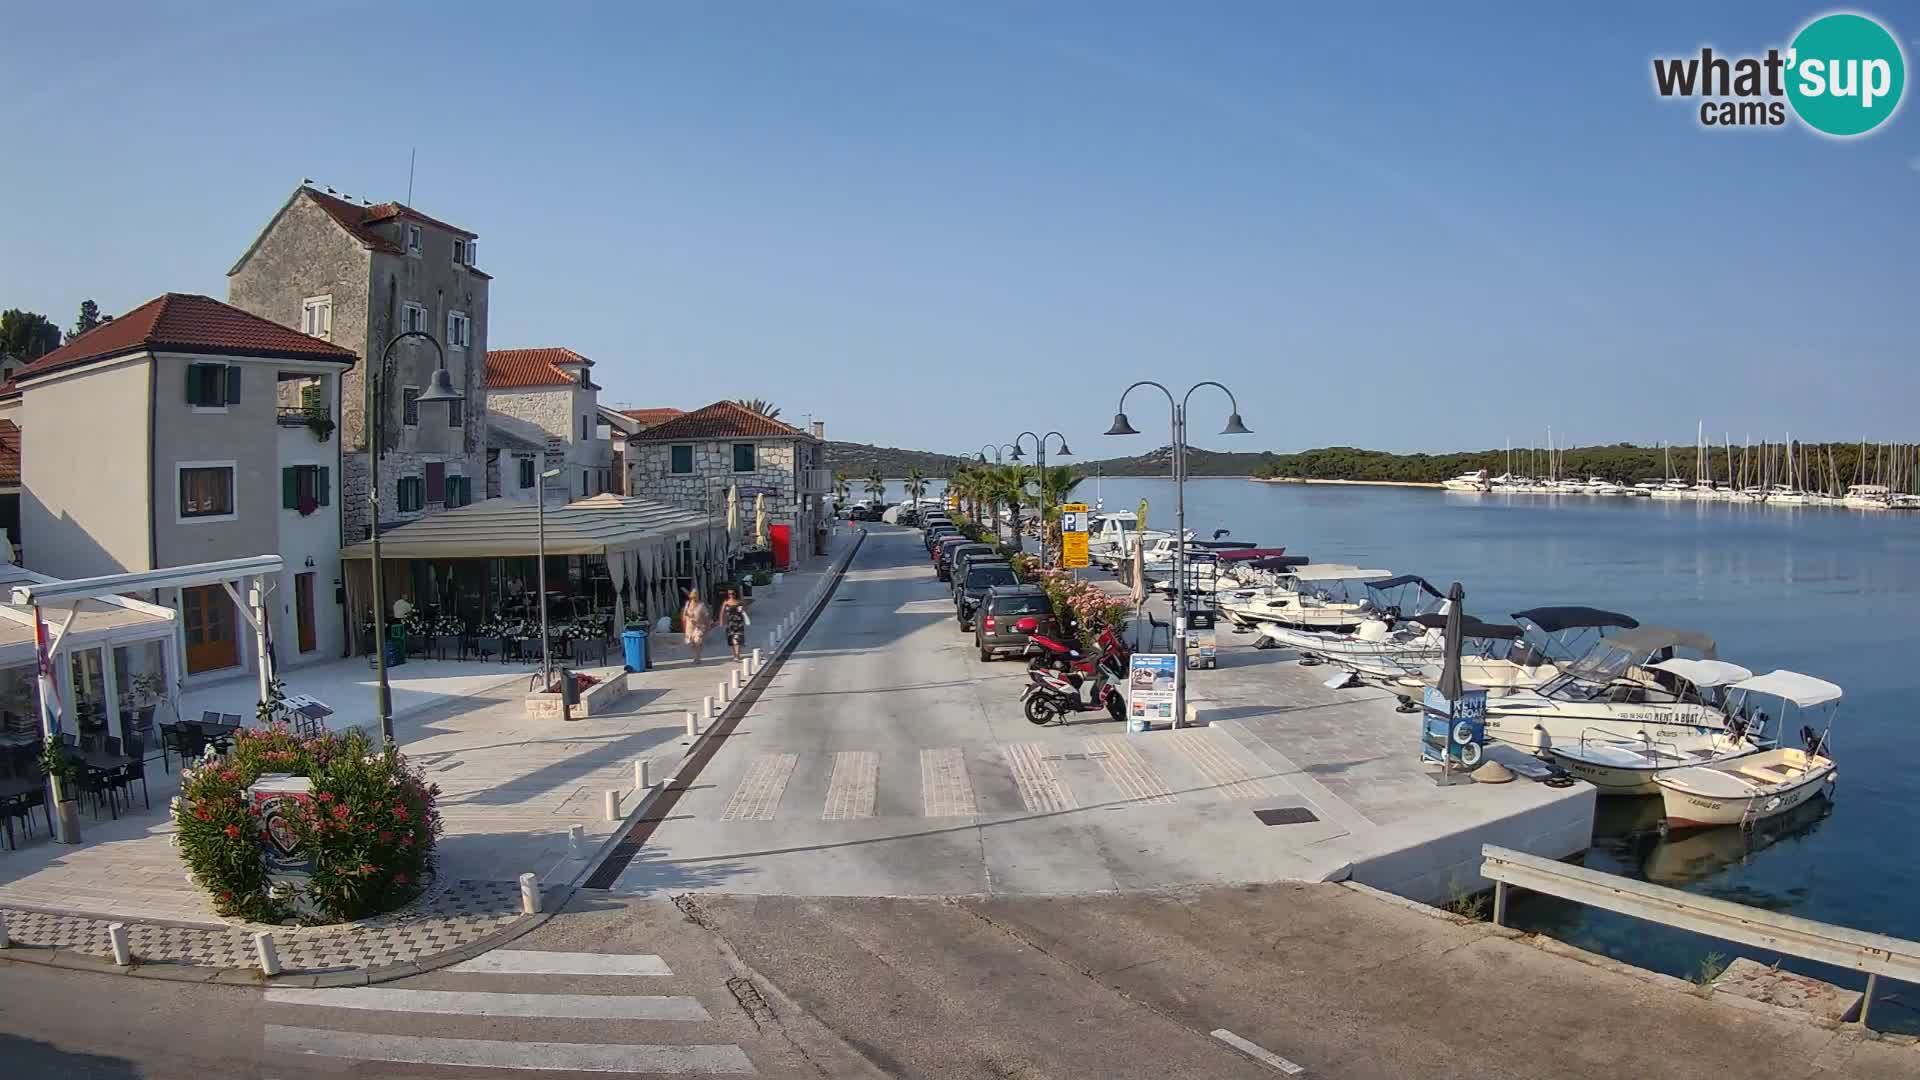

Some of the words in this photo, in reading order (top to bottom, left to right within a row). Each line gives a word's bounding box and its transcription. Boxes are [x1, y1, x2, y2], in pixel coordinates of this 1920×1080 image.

[1064, 514, 1075, 530] P
[1453, 696, 1485, 710] RENT
[1453, 710, 1459, 719] A
[1461, 708, 1485, 719] BOAT
[1654, 712, 1673, 722] RENT
[1681, 713, 1698, 724] BOAT
